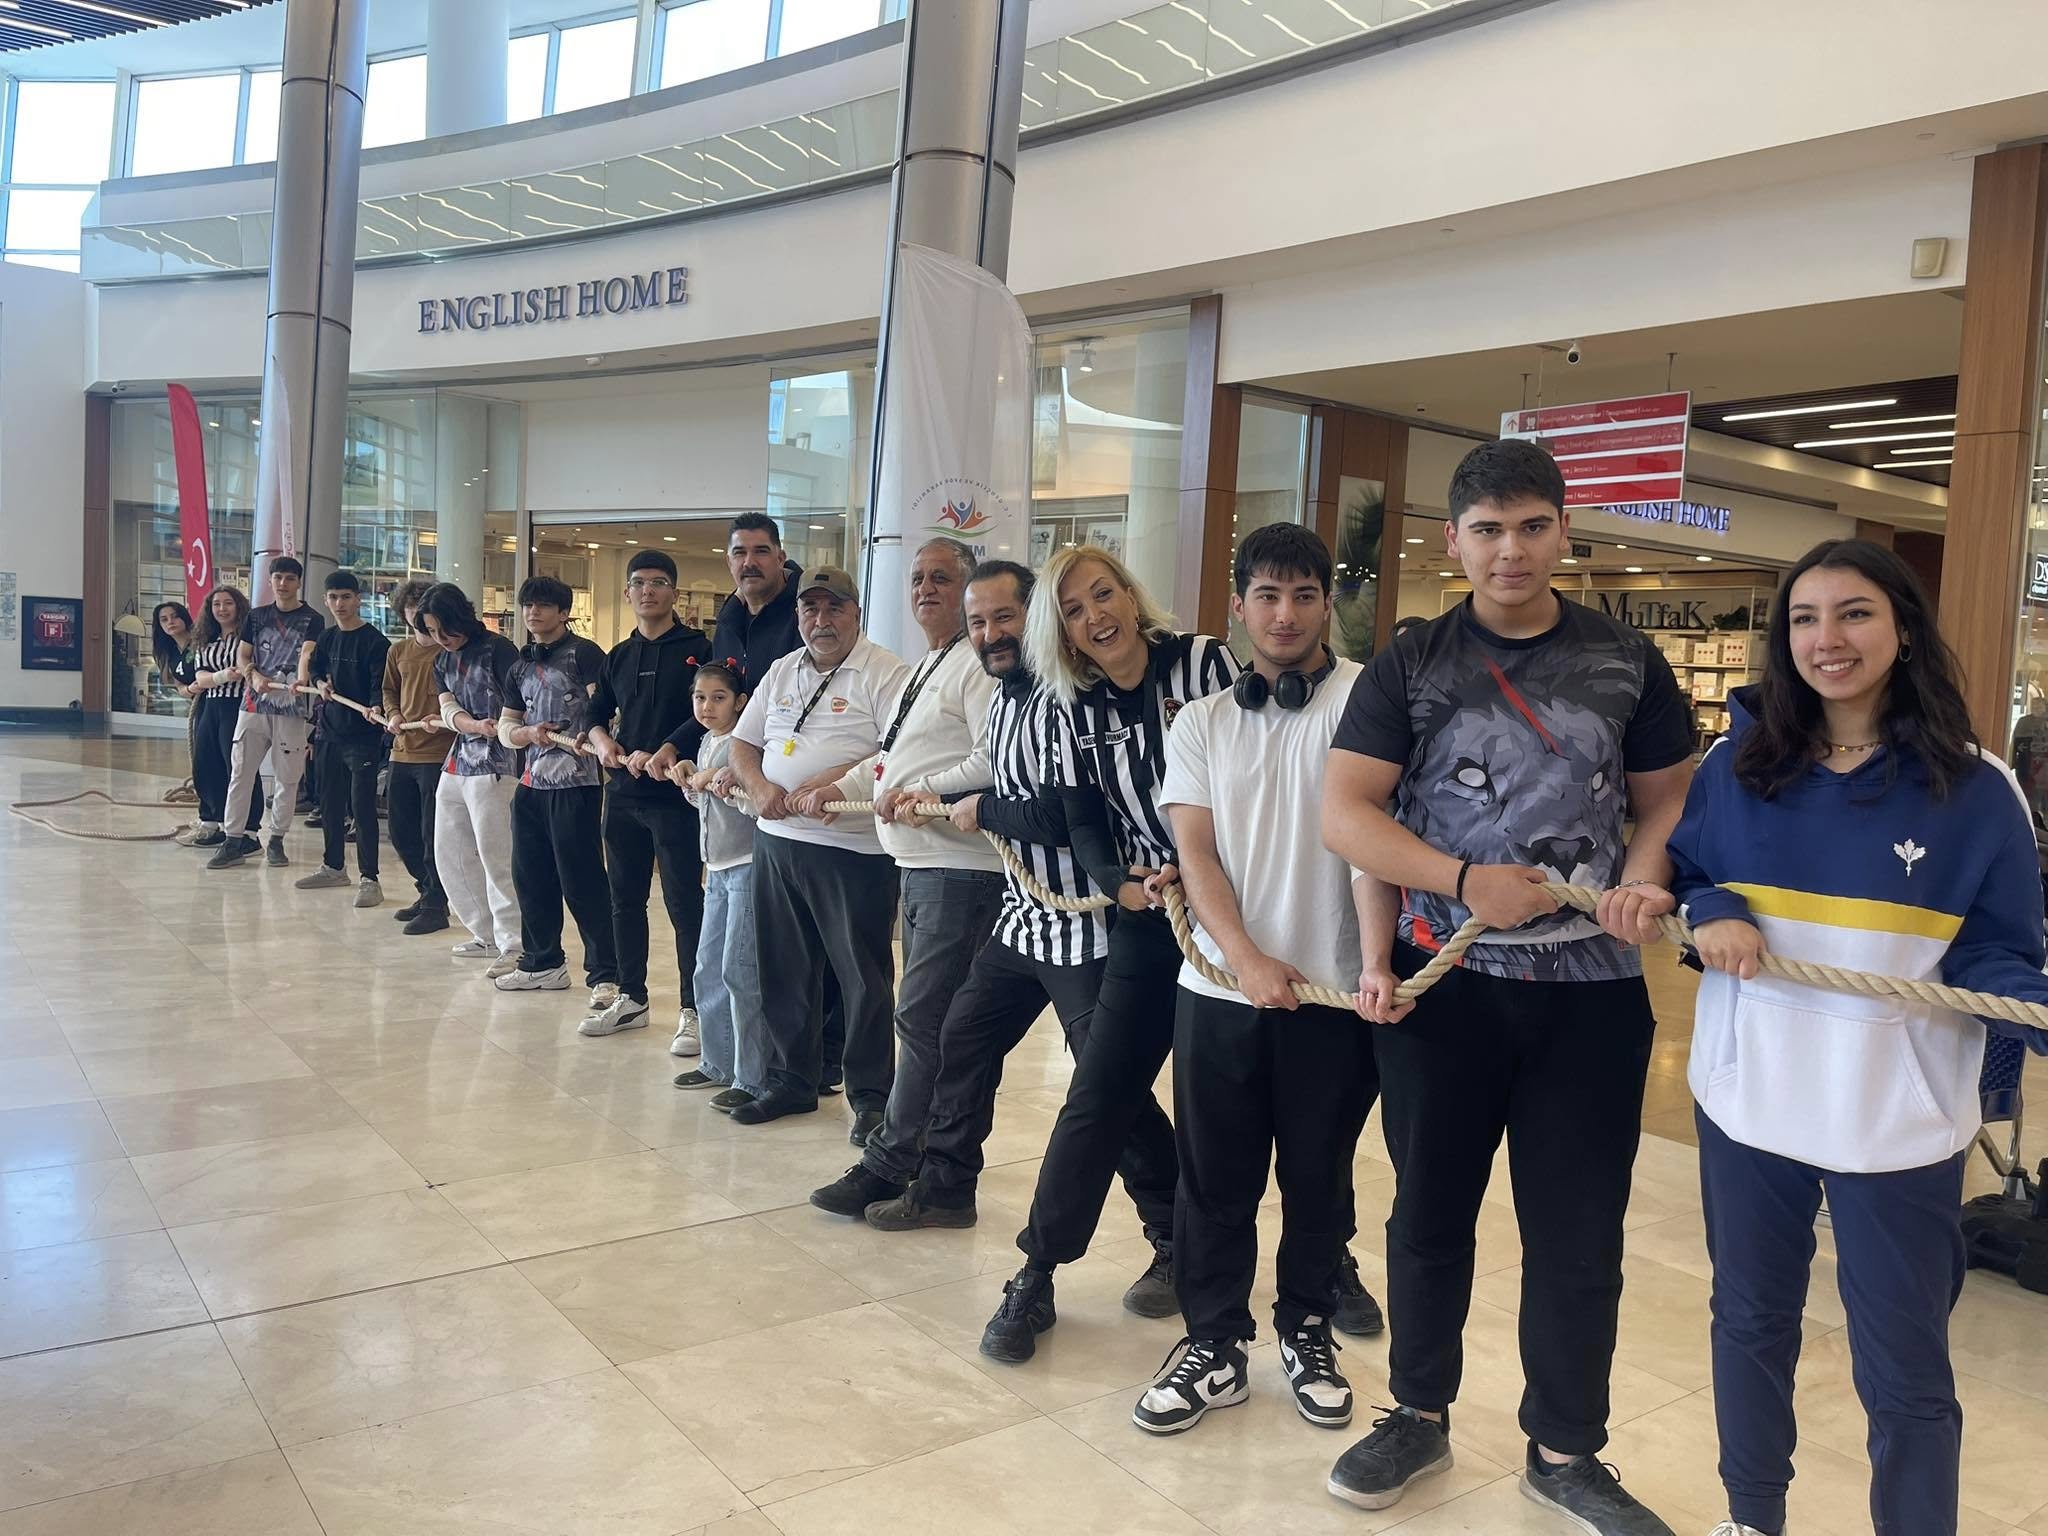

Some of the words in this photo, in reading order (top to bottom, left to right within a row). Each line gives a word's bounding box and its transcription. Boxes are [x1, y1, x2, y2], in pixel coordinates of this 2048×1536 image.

[418, 284, 569, 333] ENGLISH
[576, 267, 690, 317] HOME
[1680, 501, 1730, 531] HOME
[175, 661, 185, 676] 4
